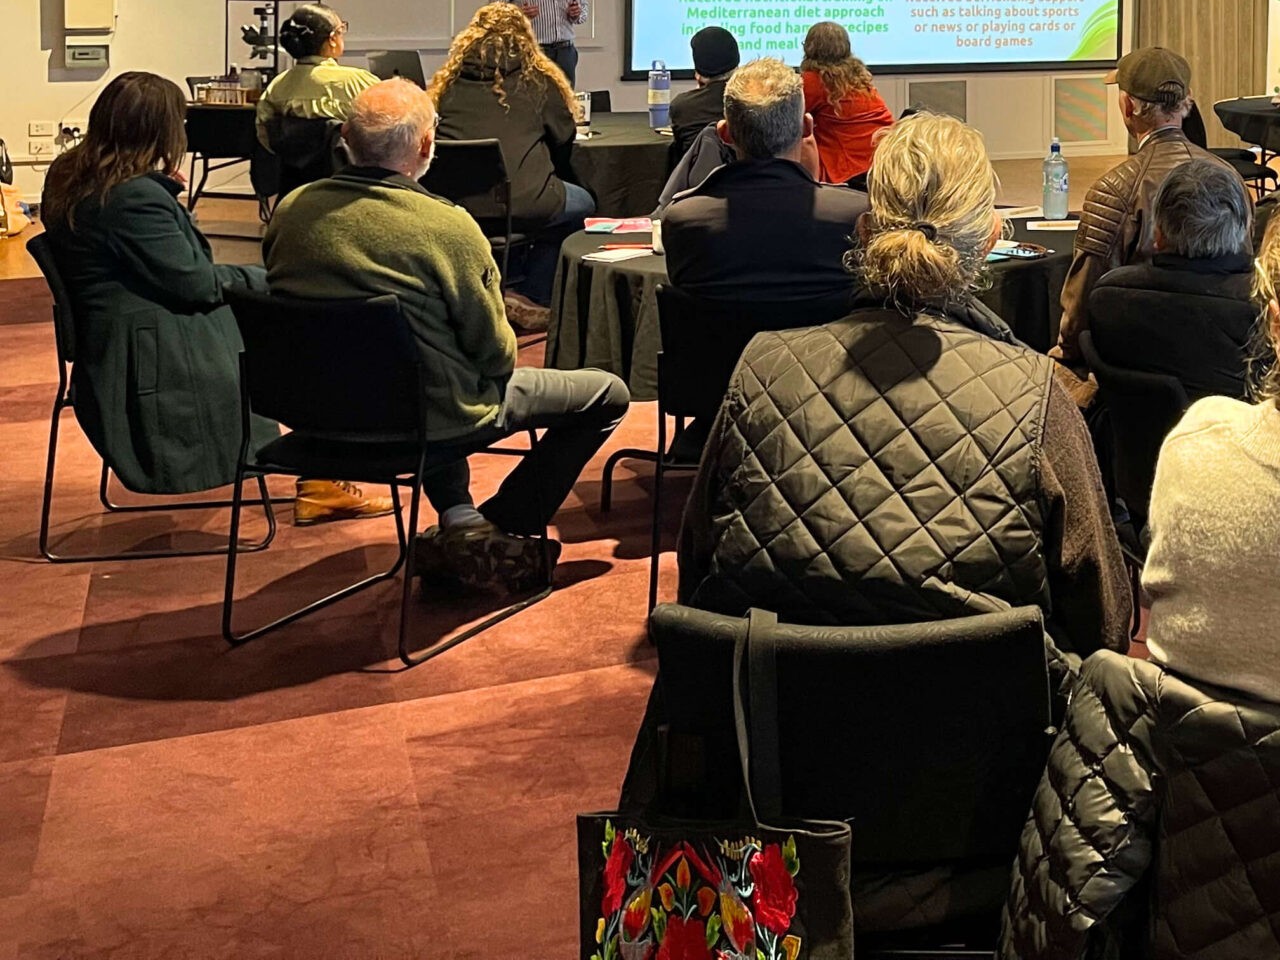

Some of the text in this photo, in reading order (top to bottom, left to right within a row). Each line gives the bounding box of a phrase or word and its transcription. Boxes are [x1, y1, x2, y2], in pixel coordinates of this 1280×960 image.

[687, 5, 885, 20] Mediterranean diet approach
[910, 6, 1079, 19] such as talking about sports
[749, 22, 781, 34] food
[914, 20, 1076, 34] or news or playing cards or
[739, 36, 798, 50] and meal
[956, 35, 1033, 49] board games
